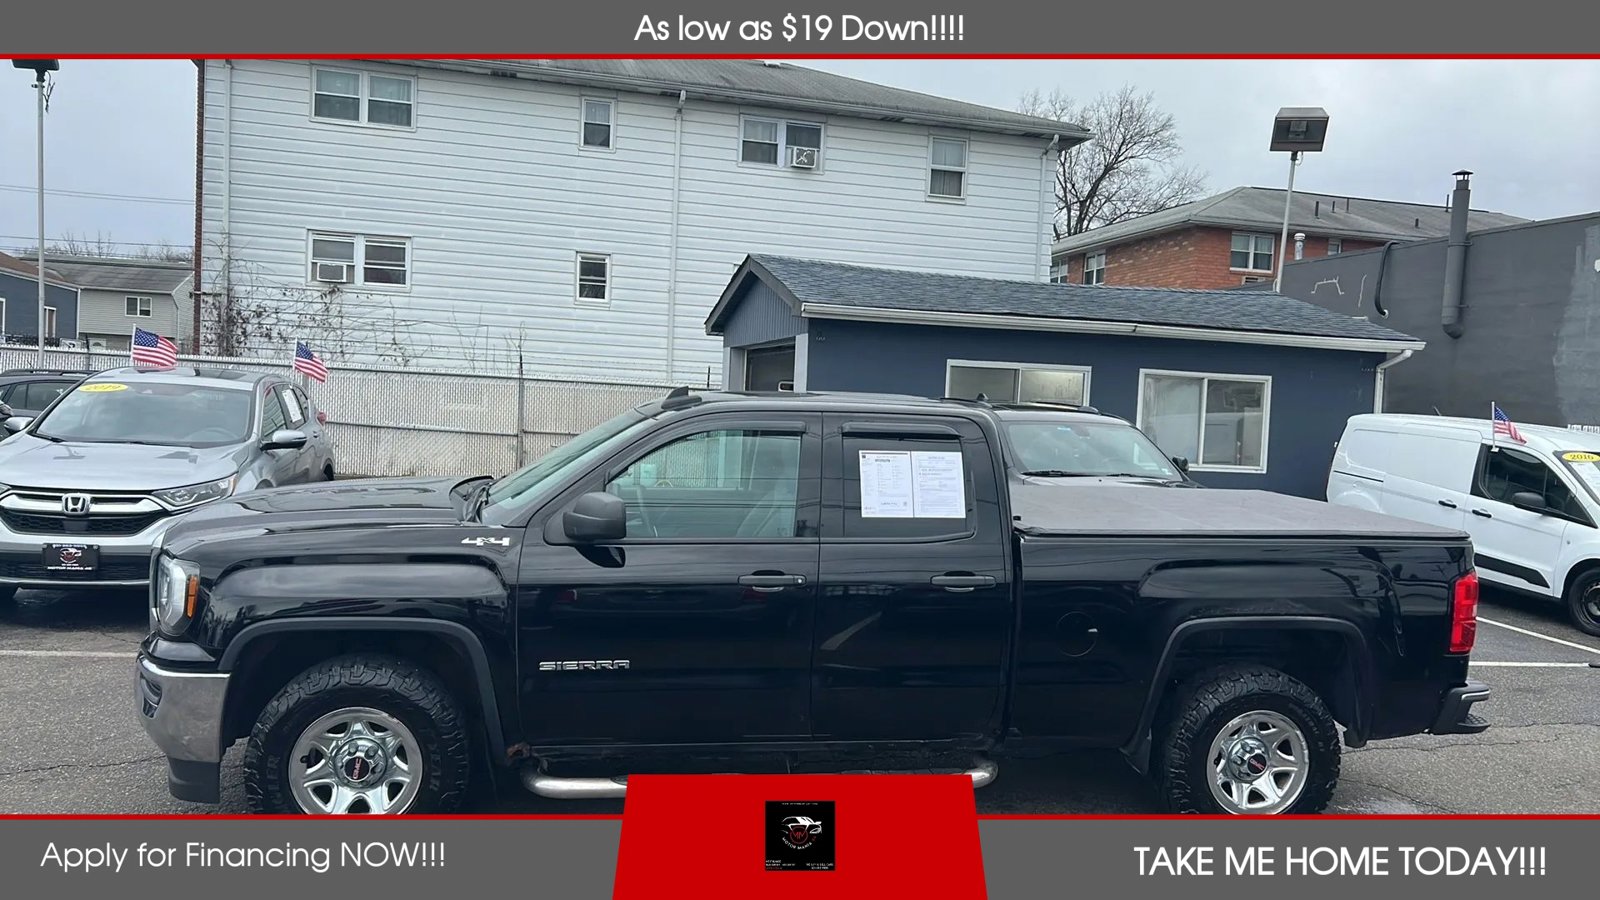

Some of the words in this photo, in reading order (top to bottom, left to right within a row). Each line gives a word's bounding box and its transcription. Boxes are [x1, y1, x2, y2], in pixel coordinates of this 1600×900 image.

[1570, 453, 1595, 461] 2016
[539, 660, 630, 671] SIERRA
[352, 757, 362, 779] GMC
